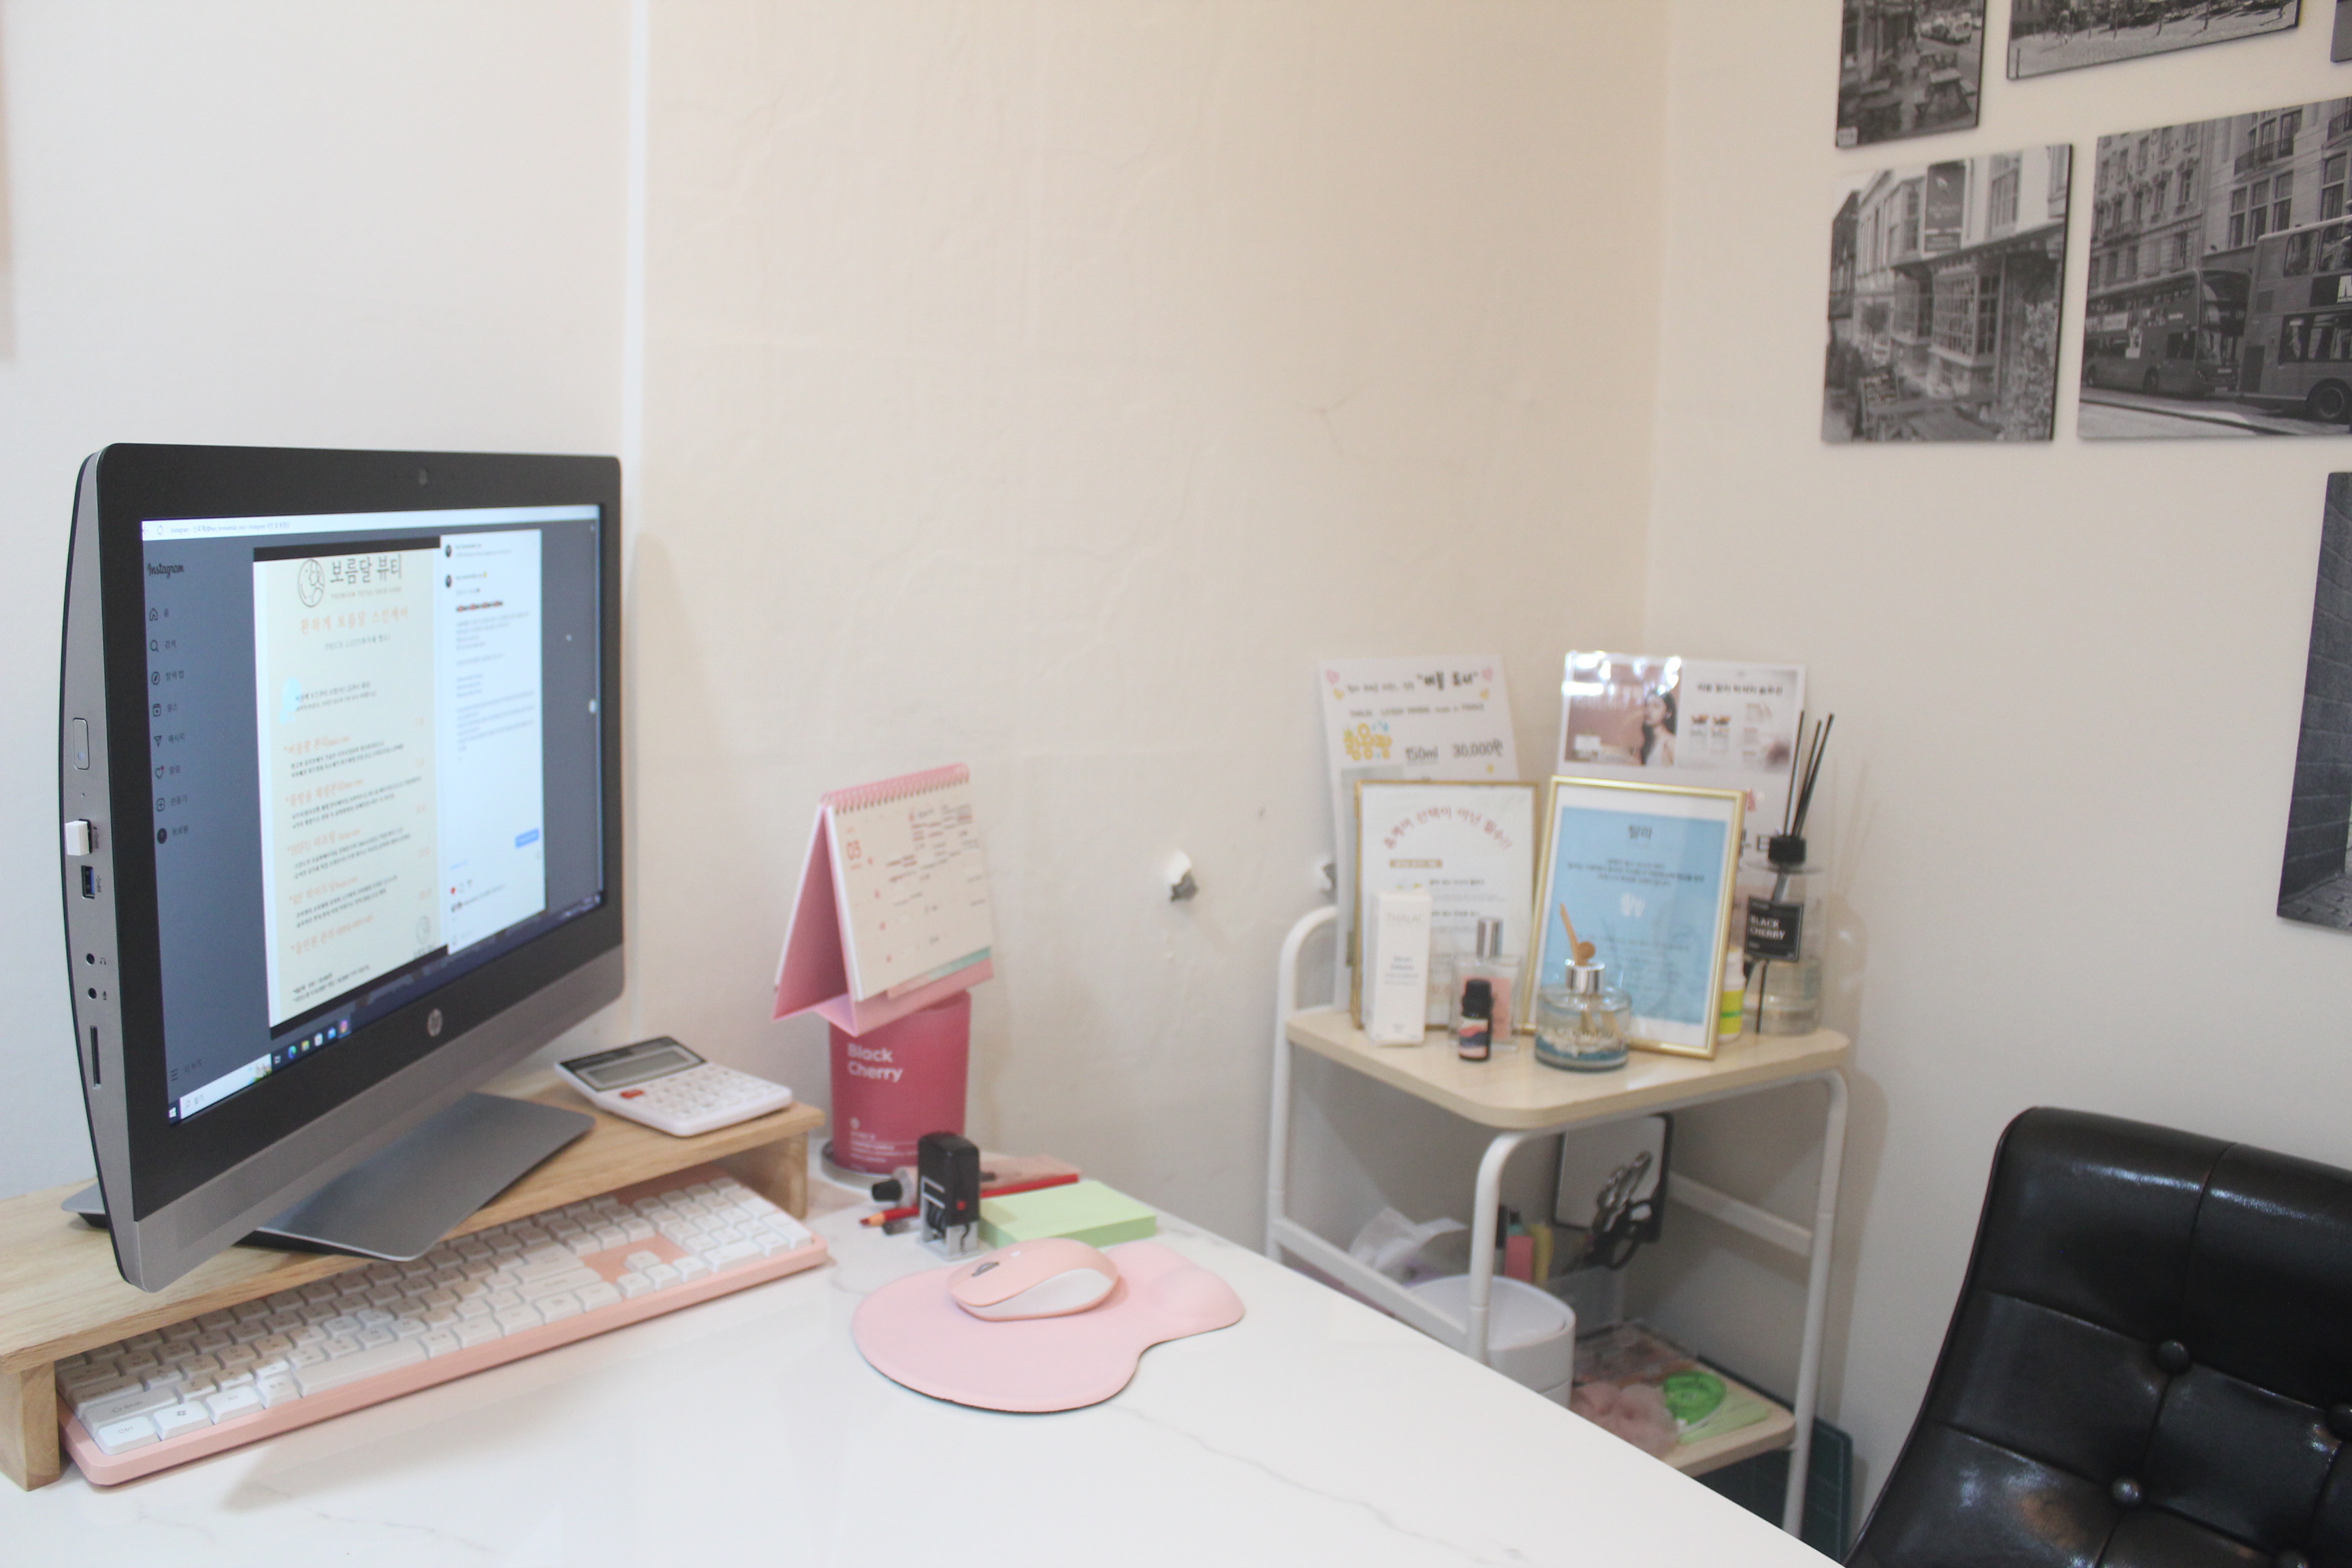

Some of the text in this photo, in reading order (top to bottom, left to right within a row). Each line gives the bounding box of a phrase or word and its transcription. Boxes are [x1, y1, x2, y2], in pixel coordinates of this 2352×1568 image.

[148, 563, 184, 578] Instagram
[329, 553, 402, 585] 보름달 뷰티
[1750, 915, 1780, 930] BLACK
[1749, 927, 1786, 941] CHERRY
[847, 1043, 893, 1062] Black
[847, 1060, 903, 1083] Cherry
[118, 1426, 134, 1434] Ctrl
